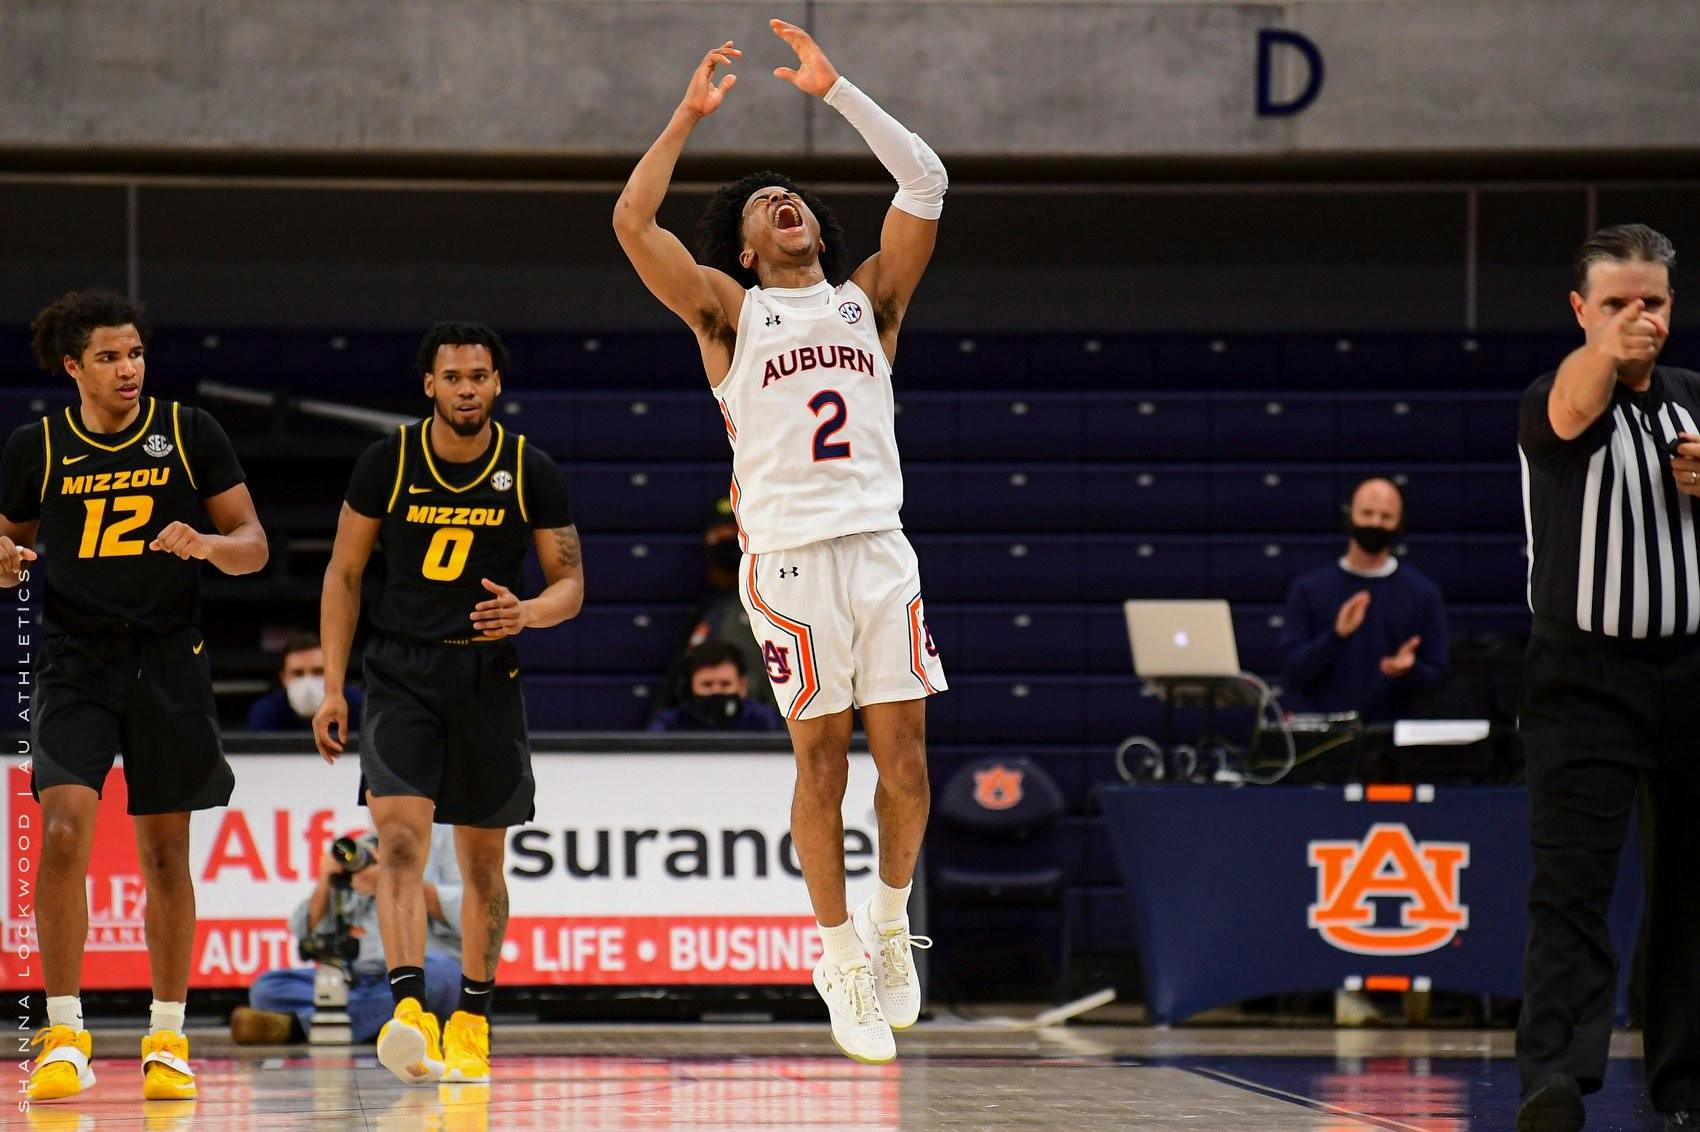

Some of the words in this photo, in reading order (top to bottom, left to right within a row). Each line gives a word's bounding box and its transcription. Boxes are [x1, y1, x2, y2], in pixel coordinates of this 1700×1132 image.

[1254, 28, 1324, 119] D
[839, 302, 862, 324] SEC
[762, 345, 874, 388] AUBURN
[147, 434, 168, 452] SEC
[807, 389, 851, 462] 2
[62, 466, 169, 495] MIZZOU
[491, 470, 513, 491] SEC
[78, 495, 154, 559] 12
[406, 505, 505, 527] MIZZOU
[421, 528, 474, 582] 0
[202, 809, 370, 882] Alf
[511, 828, 873, 879] surance
[532, 927, 626, 971] LIFE
[670, 927, 823, 971] BUSINE
